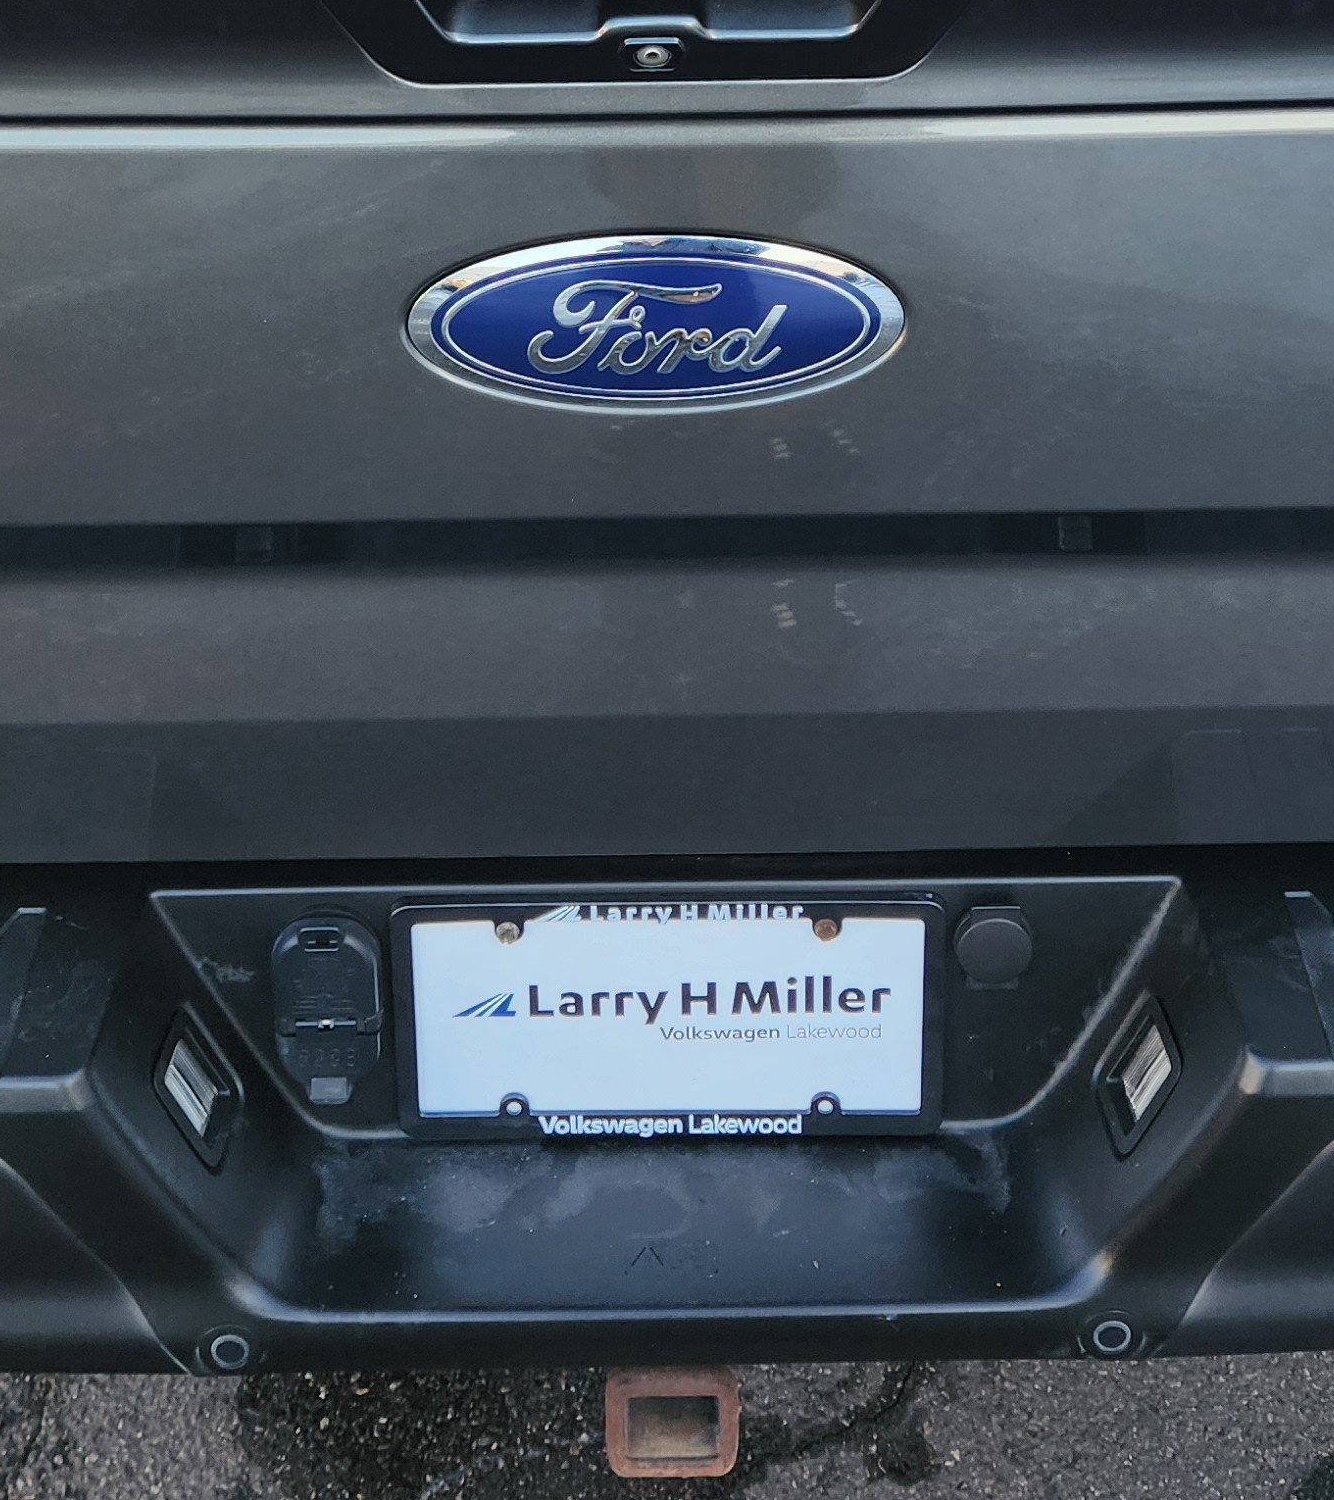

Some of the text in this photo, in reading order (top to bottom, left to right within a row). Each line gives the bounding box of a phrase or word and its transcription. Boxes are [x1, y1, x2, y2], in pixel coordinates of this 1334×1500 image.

[527, 279, 788, 375] Ford
[589, 903, 804, 925] Larry H Miller
[528, 975, 891, 1024] Larry H Miller
[660, 1024, 882, 1043] Volkswagen Lakewood
[538, 1113, 802, 1138] Volkswagen Lakewood
